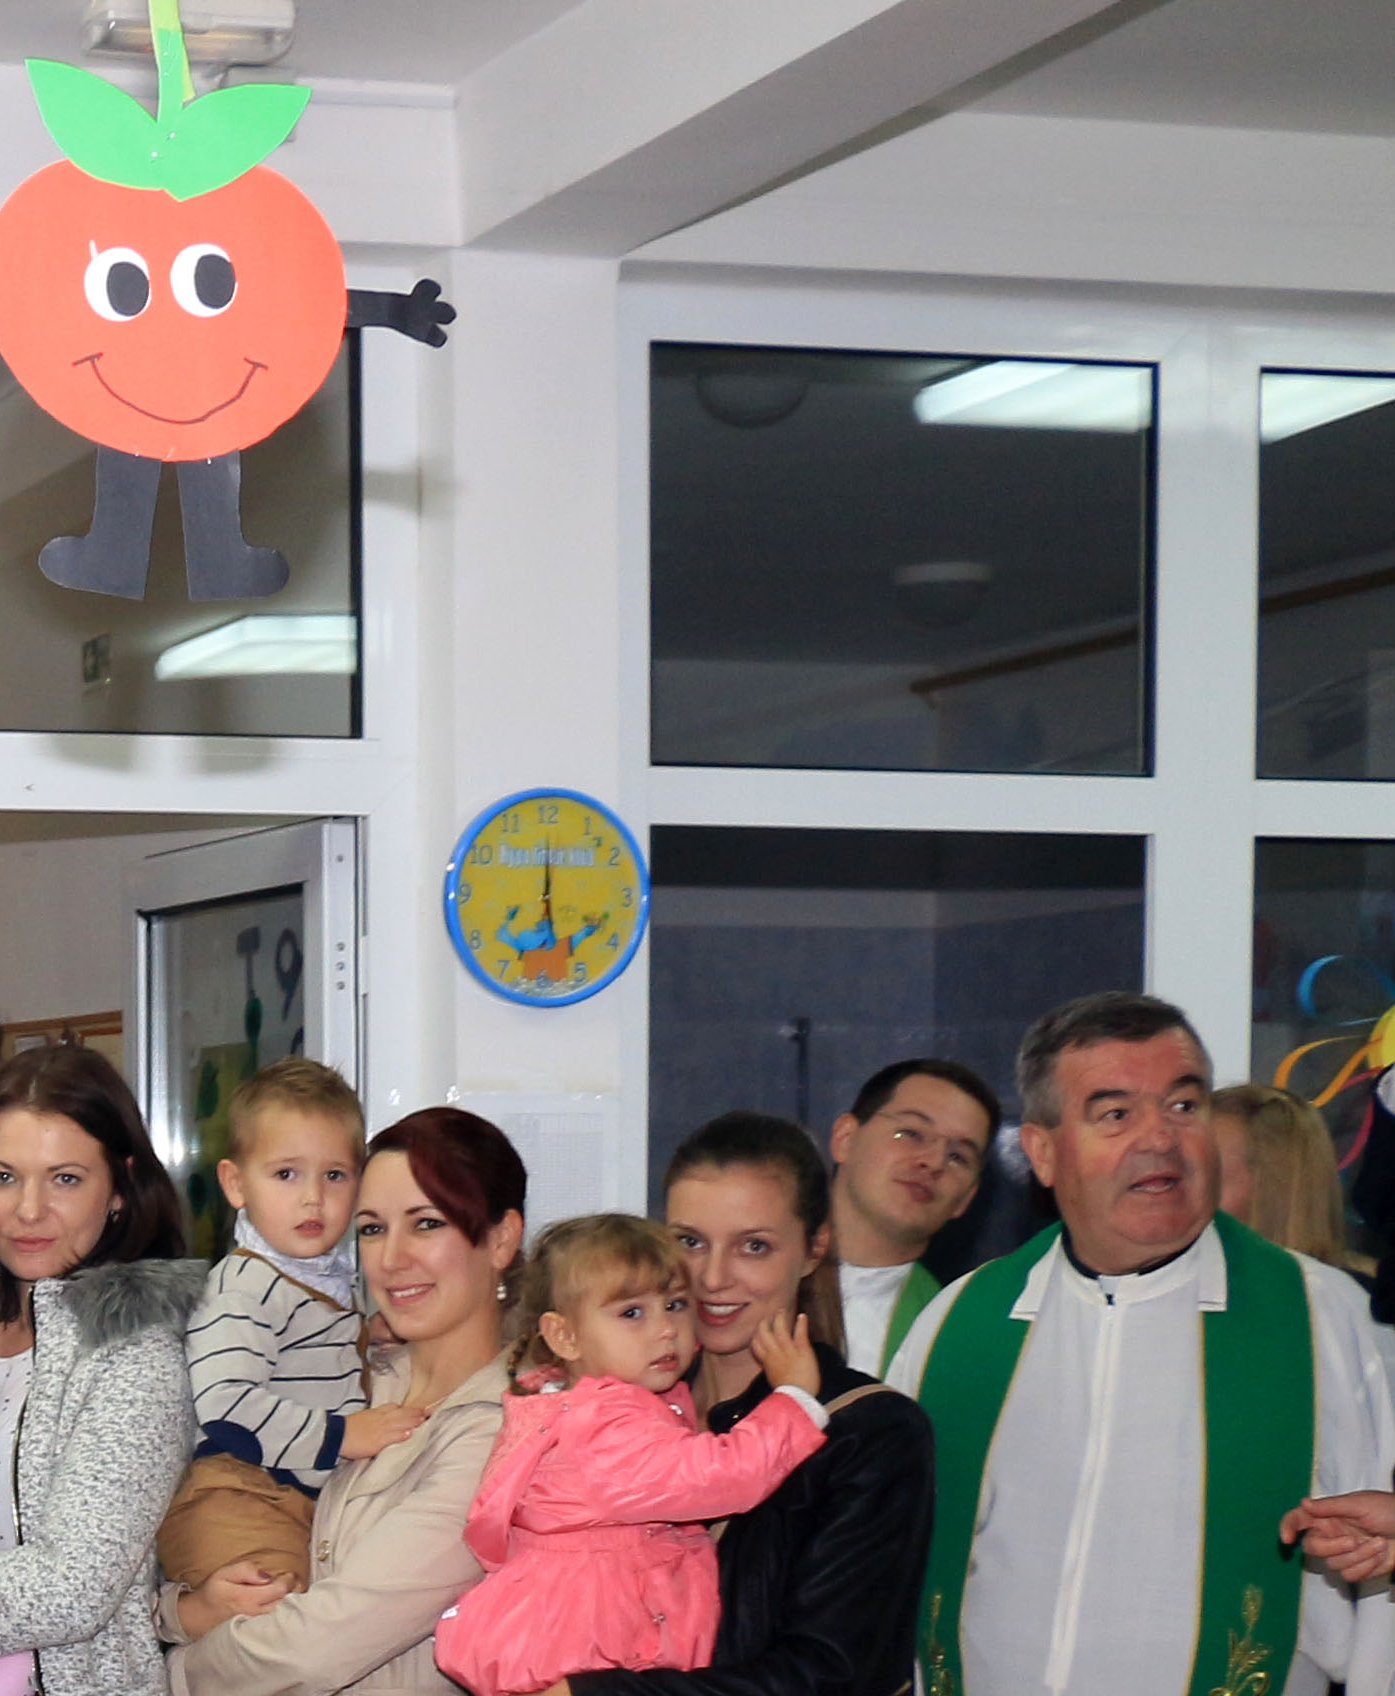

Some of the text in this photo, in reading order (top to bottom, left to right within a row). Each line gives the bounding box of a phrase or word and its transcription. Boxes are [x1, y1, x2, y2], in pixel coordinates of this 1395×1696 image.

[501, 813, 520, 833] 11
[538, 805, 559, 824] 12
[583, 817, 592, 836] 1
[471, 845, 493, 865] 10
[608, 847, 620, 867] 2
[458, 883, 472, 905] 9
[622, 888, 633, 907] 3
[469, 931, 482, 950] 8
[606, 932, 619, 950] 4
[496, 960, 510, 979] 7
[536, 970, 554, 988] 6
[574, 962, 587, 984] 5
